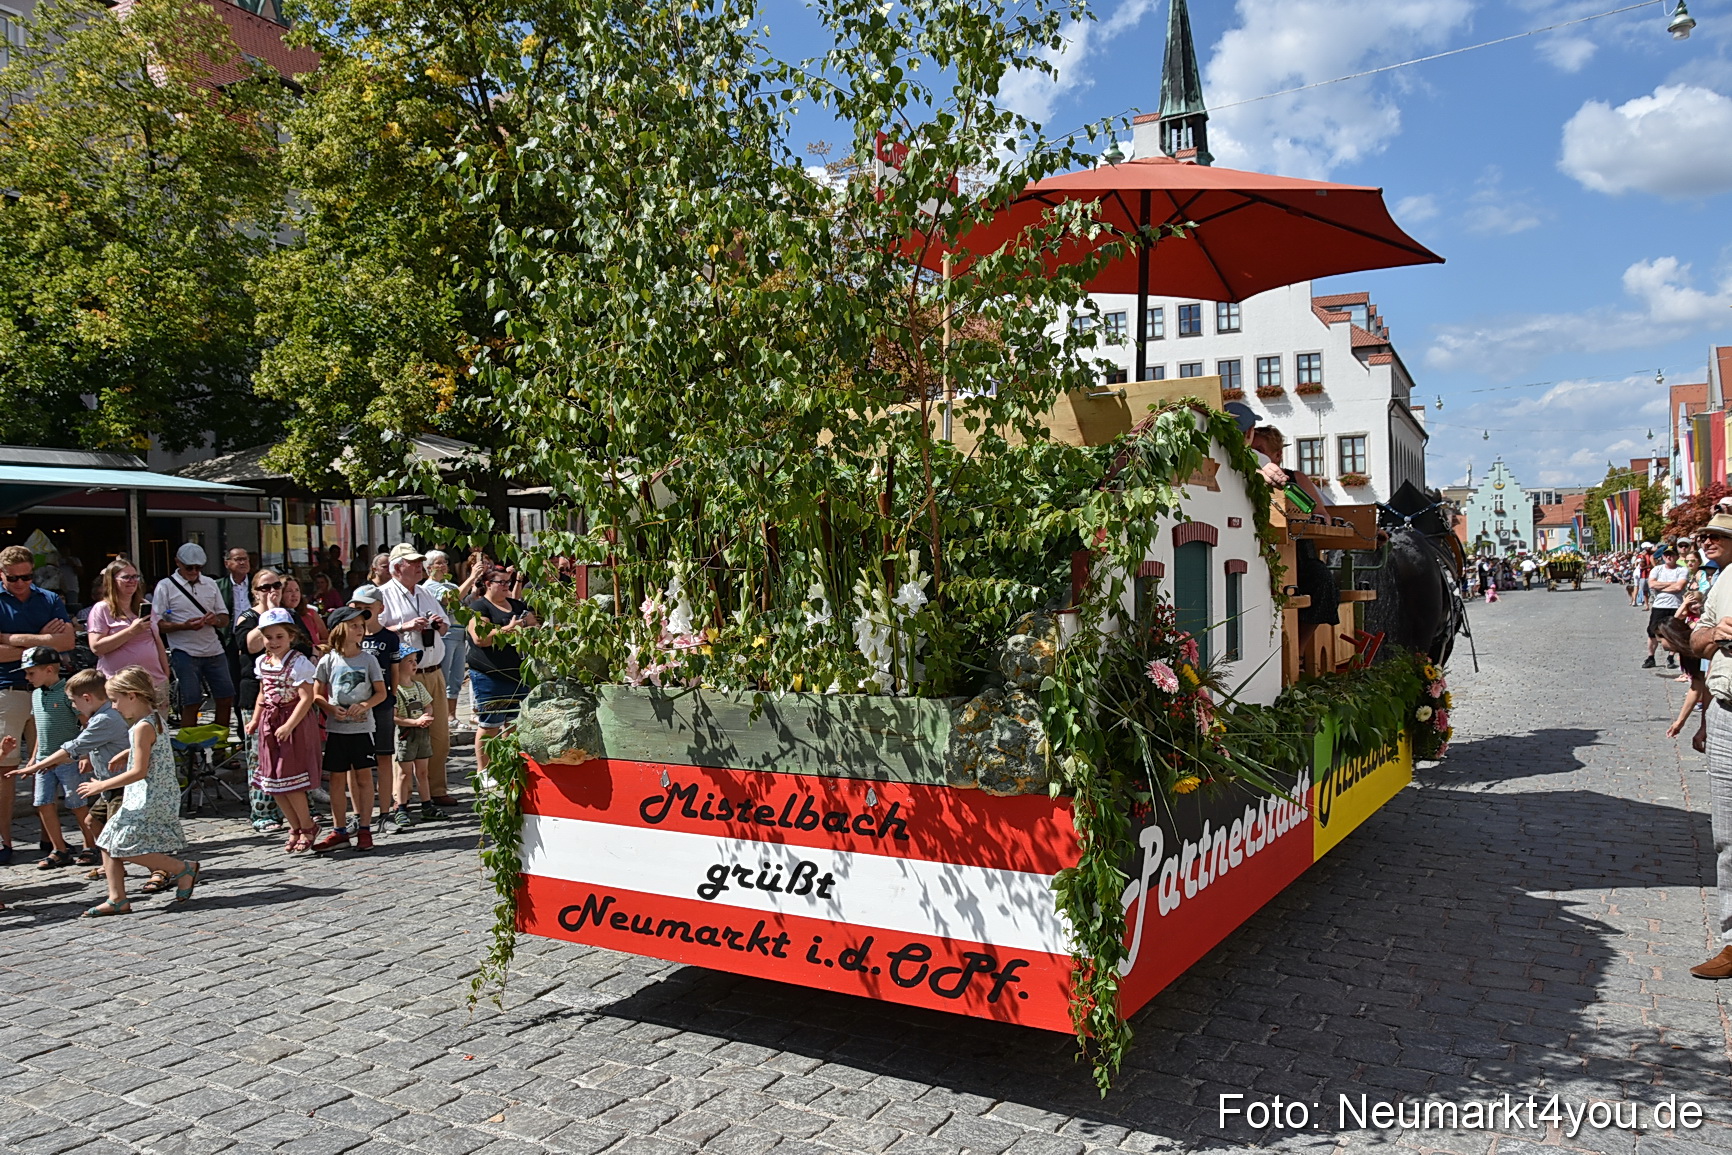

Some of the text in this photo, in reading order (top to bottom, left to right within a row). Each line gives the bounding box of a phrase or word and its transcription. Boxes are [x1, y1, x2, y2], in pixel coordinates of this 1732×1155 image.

[358, 640, 387, 651] OLO
[639, 782, 910, 842] Mistelbach
[697, 860, 836, 901] grüßt
[1117, 765, 1310, 977] Partnerstadt
[558, 893, 791, 959] Neumarkt
